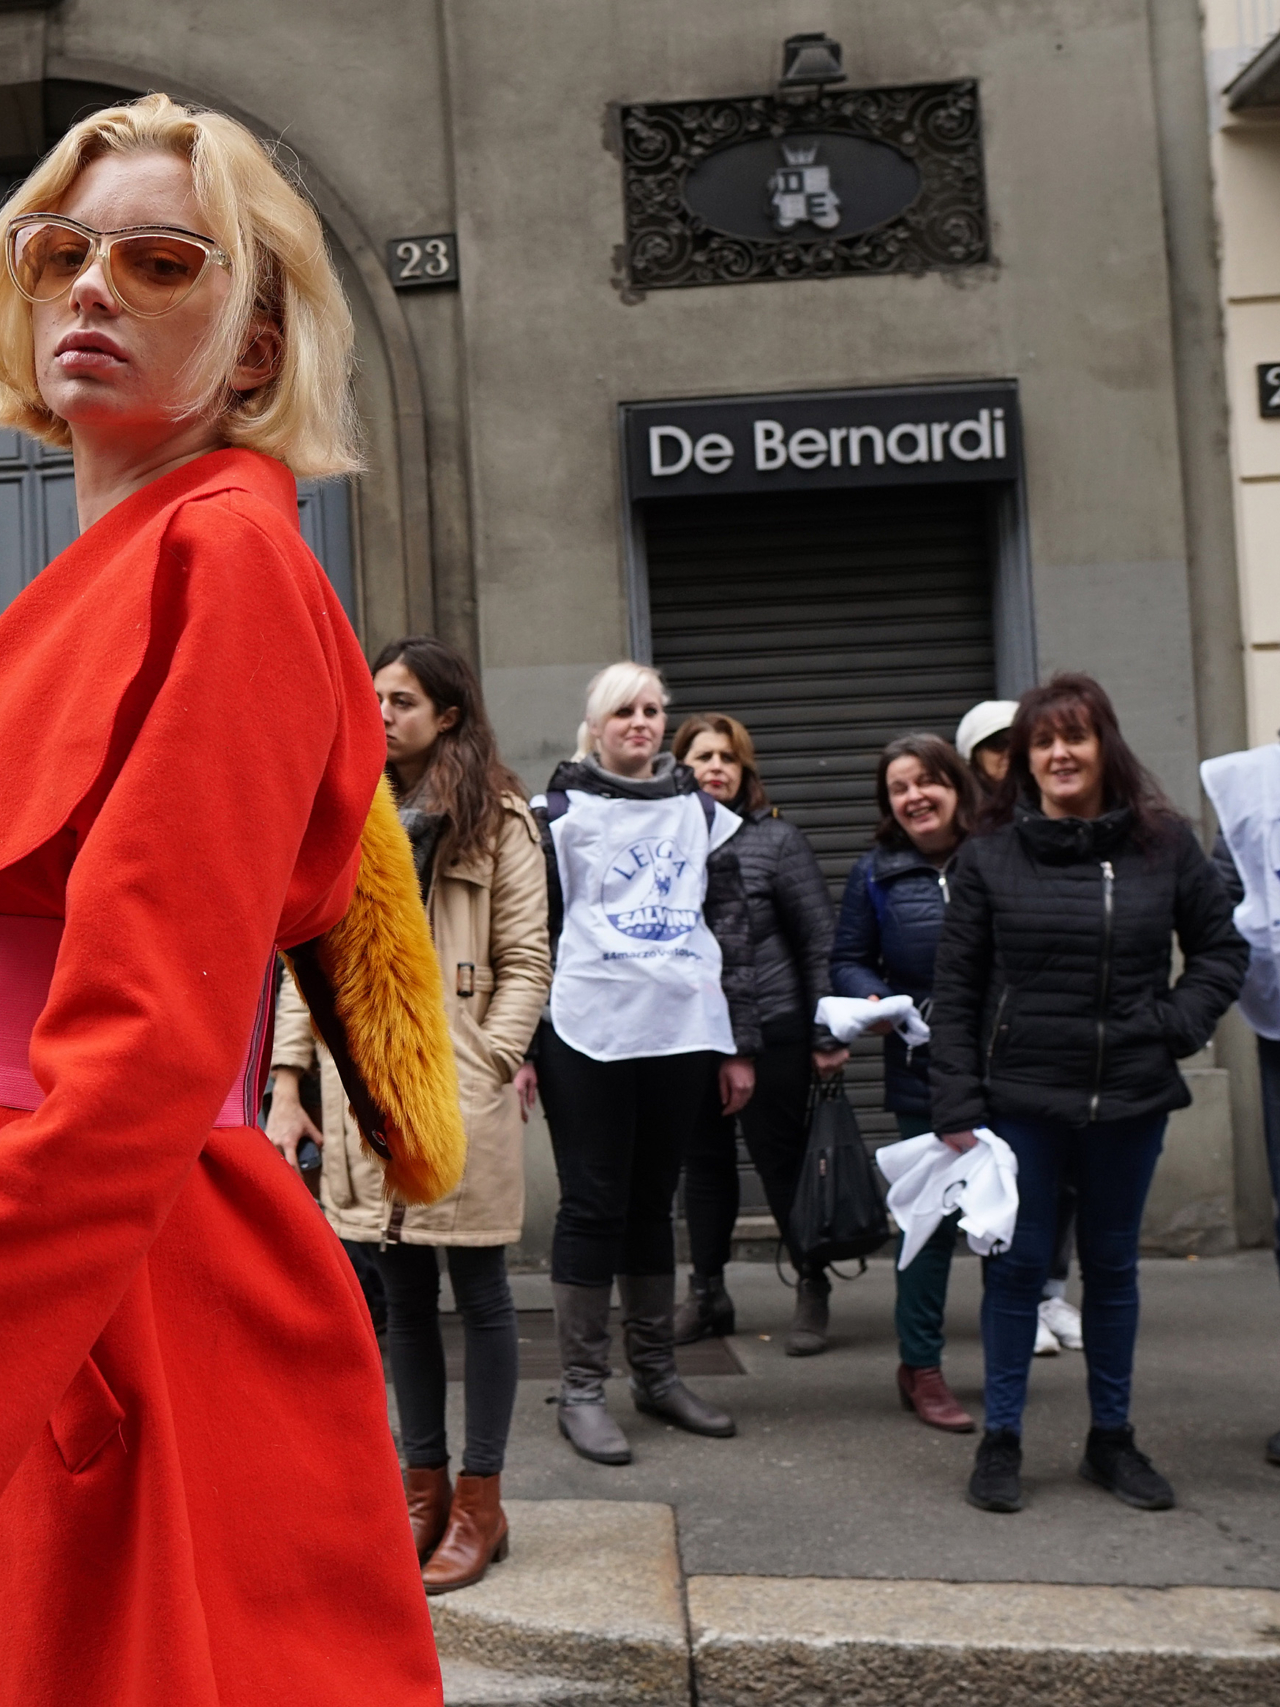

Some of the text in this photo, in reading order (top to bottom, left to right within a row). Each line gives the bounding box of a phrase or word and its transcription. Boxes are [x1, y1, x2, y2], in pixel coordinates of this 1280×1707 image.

[396, 239, 449, 277] 23
[649, 408, 1006, 476] De Bernardi
[612, 840, 686, 881] LEGA
[617, 906, 697, 930] SALVINI
